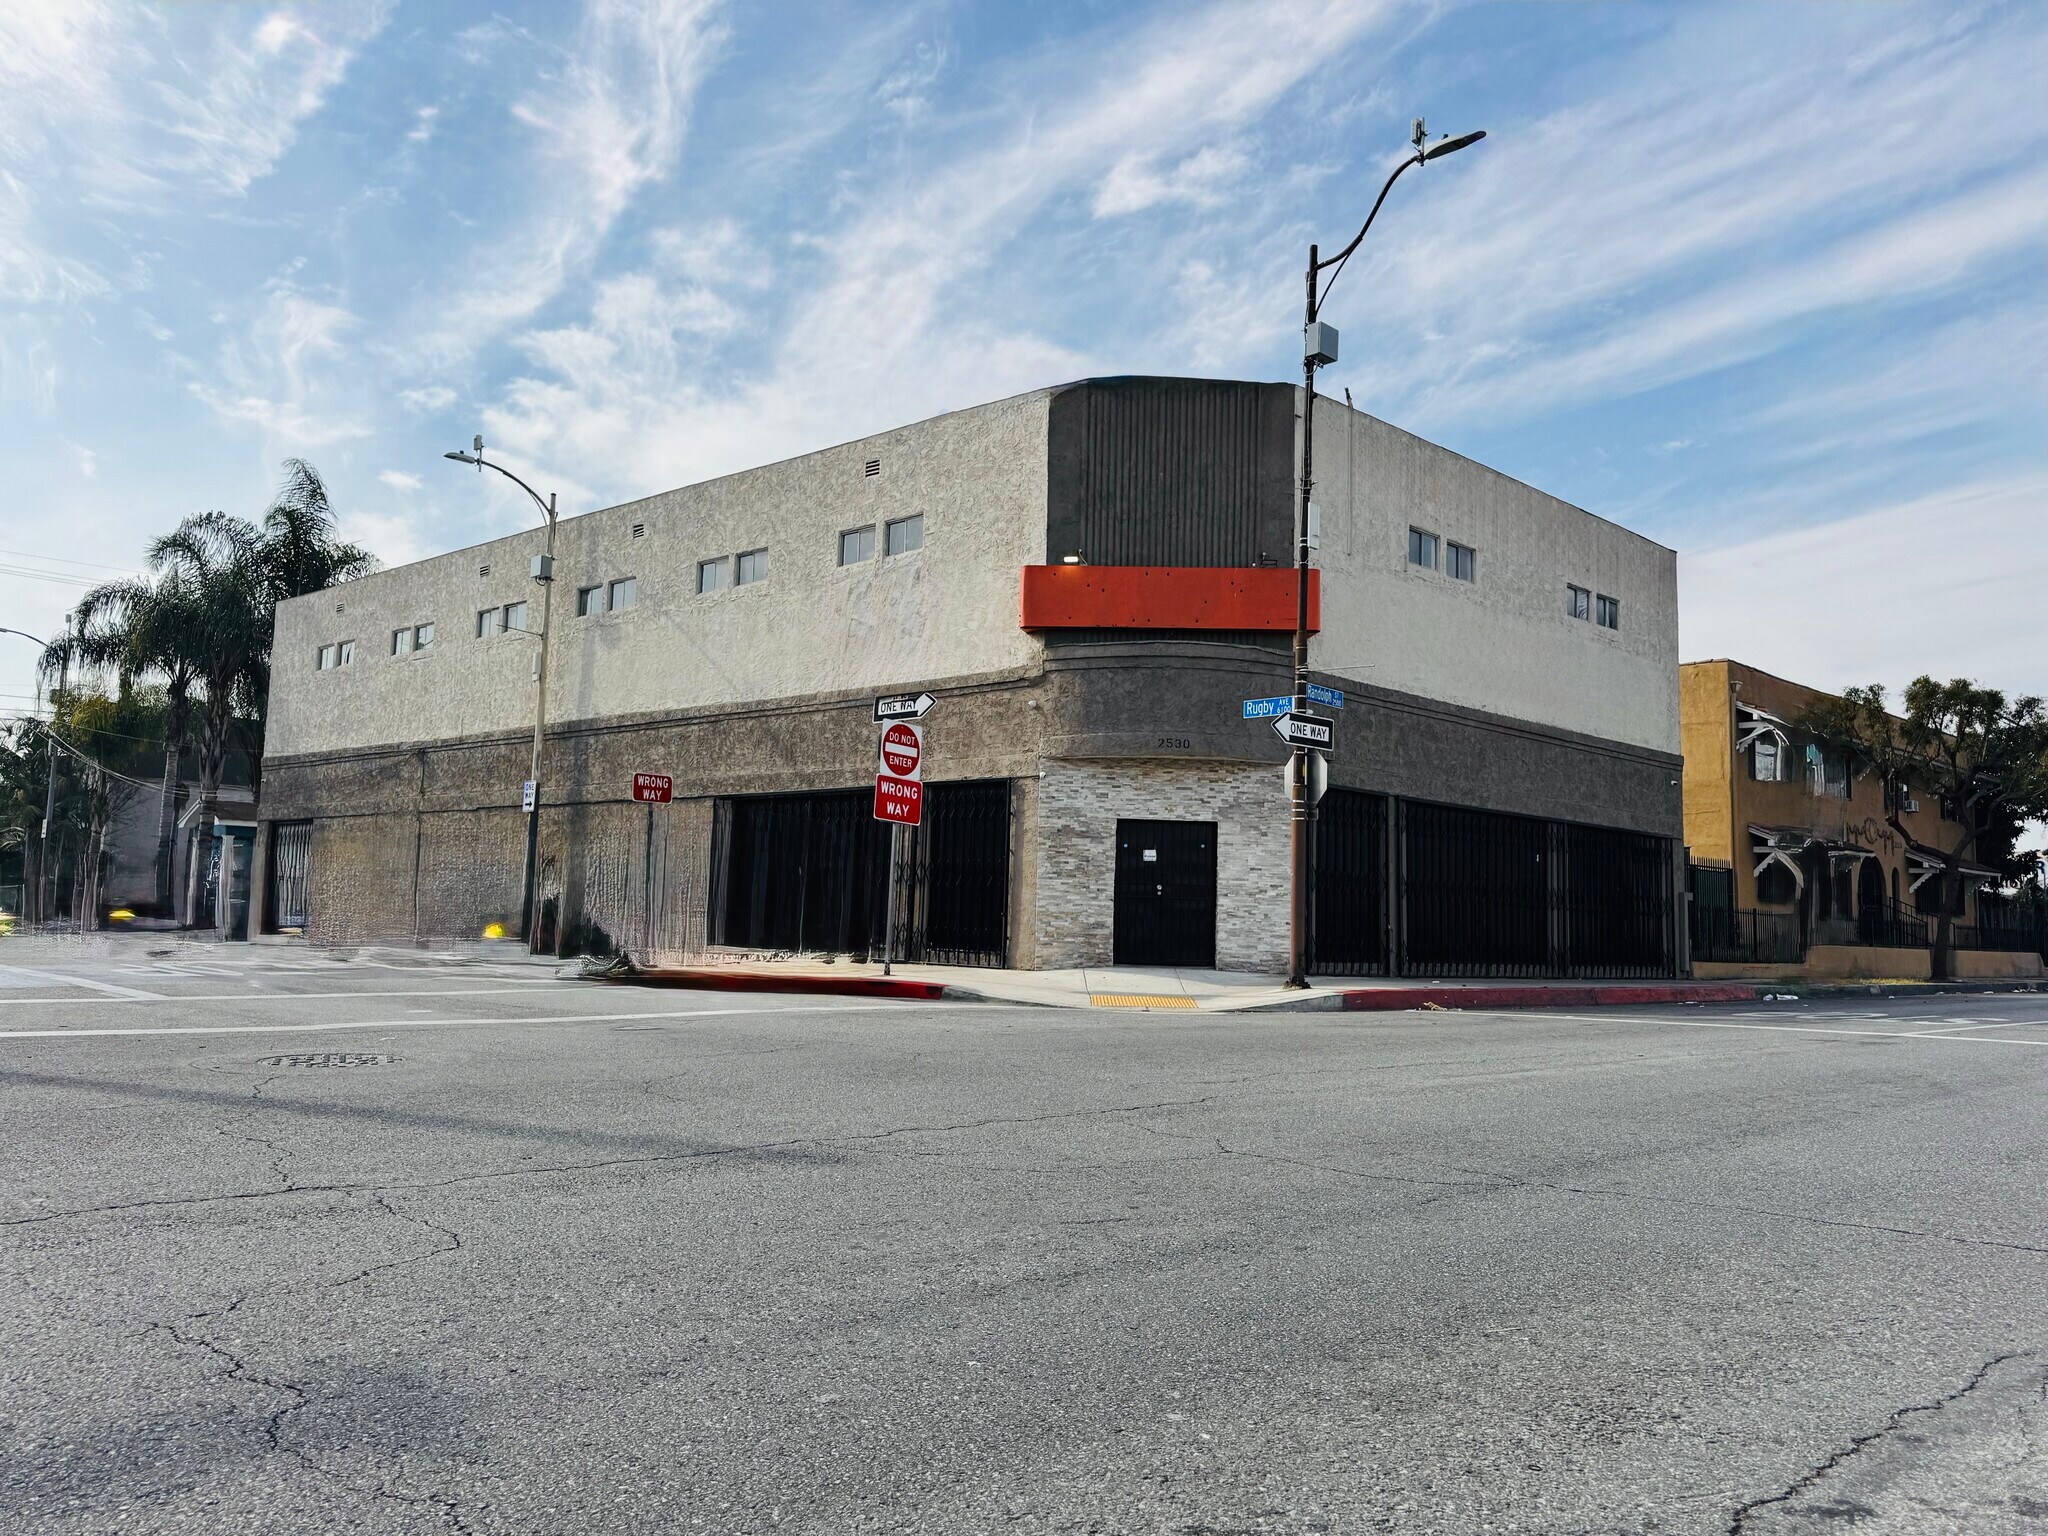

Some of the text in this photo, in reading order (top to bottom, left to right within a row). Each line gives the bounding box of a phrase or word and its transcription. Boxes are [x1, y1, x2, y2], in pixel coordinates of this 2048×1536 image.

[1308, 685, 1332, 704] Randolph
[881, 700, 917, 713] ONE WAY
[1247, 701, 1274, 716] Rugby
[1291, 723, 1327, 739] ONE WAY
[890, 732, 915, 745] DO NOT
[1158, 739, 1189, 748] 2530
[890, 756, 912, 768] ENTER
[525, 783, 535, 791] ONE
[637, 775, 669, 789] WRONG
[525, 792, 535, 800] WAY
[642, 789, 663, 801] WAY
[880, 780, 918, 800] WRONG
[887, 802, 909, 816] WAY
